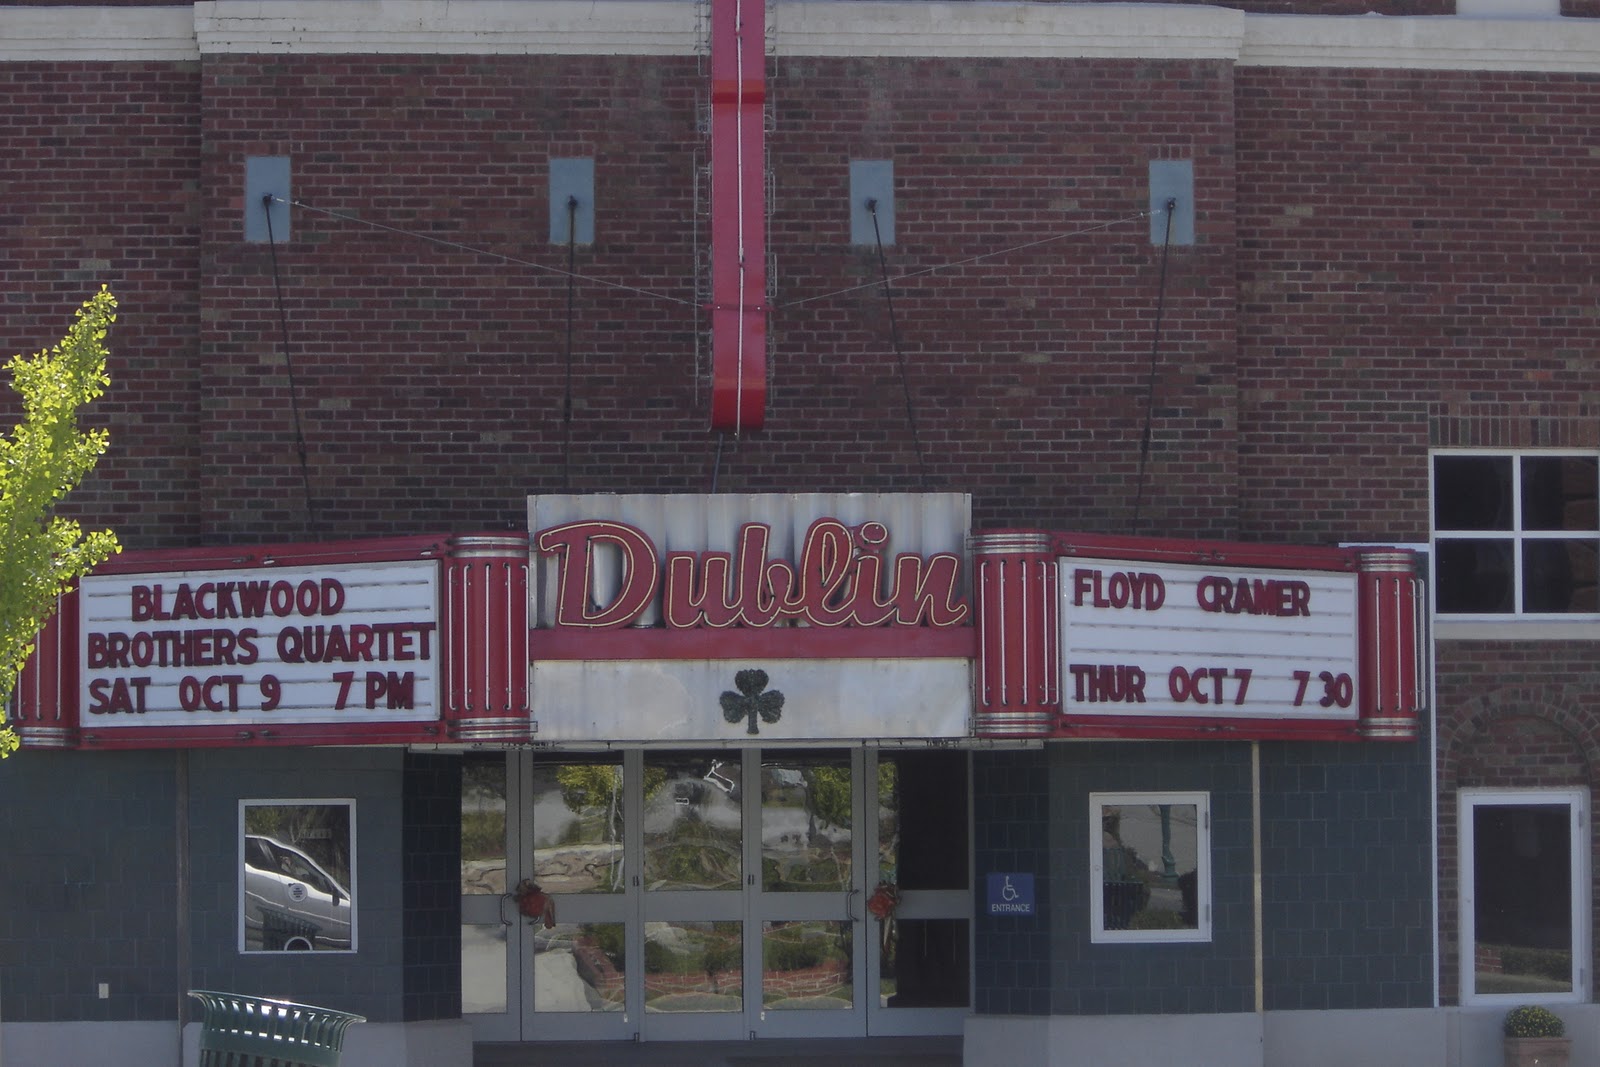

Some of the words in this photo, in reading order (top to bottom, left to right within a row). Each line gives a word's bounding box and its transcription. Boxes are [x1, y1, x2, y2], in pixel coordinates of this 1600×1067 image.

[534, 517, 968, 629] Dublin
[1074, 568, 1165, 610] FLOYD
[1197, 575, 1311, 617] CRAMER
[131, 578, 345, 622] BLACKWOOD
[87, 628, 258, 668] BROTHERS
[276, 622, 436, 663] QUARTET
[89, 677, 151, 714] SAT
[178, 675, 244, 712] OCT
[260, 674, 281, 711] 9
[333, 671, 354, 710] 7
[365, 671, 414, 710] PM
[1069, 664, 1146, 703] THUR
[991, 903, 1030, 912] ENTRANCE
